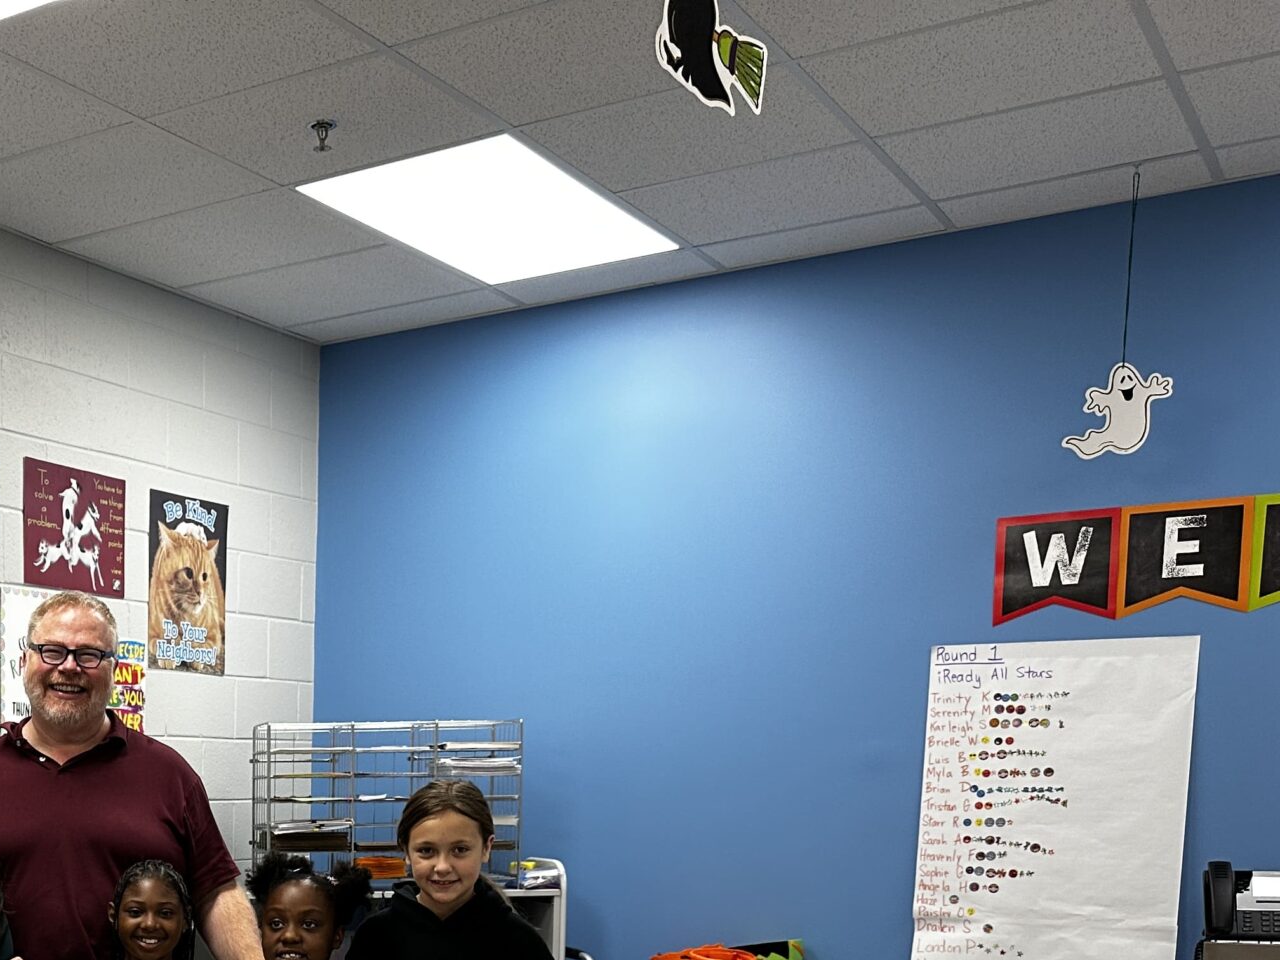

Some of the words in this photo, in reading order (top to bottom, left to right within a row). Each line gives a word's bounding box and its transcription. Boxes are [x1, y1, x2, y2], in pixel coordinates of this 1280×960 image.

[37, 468, 50, 486] To
[34, 487, 54, 501] solve
[94, 479, 103, 491] You
[104, 482, 115, 493] have
[164, 501, 183, 523] Be
[185, 499, 217, 532] Kind
[116, 552, 123, 563] of
[164, 620, 178, 640] To
[181, 621, 207, 642] Your
[117, 642, 145, 659] ECIDE
[156, 641, 217, 666] Neighbors!
[936, 646, 977, 662] Round
[987, 645, 1003, 661] 1
[114, 664, 143, 683] AN'T
[937, 668, 982, 688] iReady
[991, 666, 1008, 681] All
[1016, 666, 1053, 679] Stars
[123, 689, 143, 706] YOU
[931, 692, 970, 712] Trinity
[930, 707, 975, 721] Serenity
[928, 753, 950, 765] Luis
[926, 766, 953, 782] Myla
[926, 782, 951, 794] Brian
